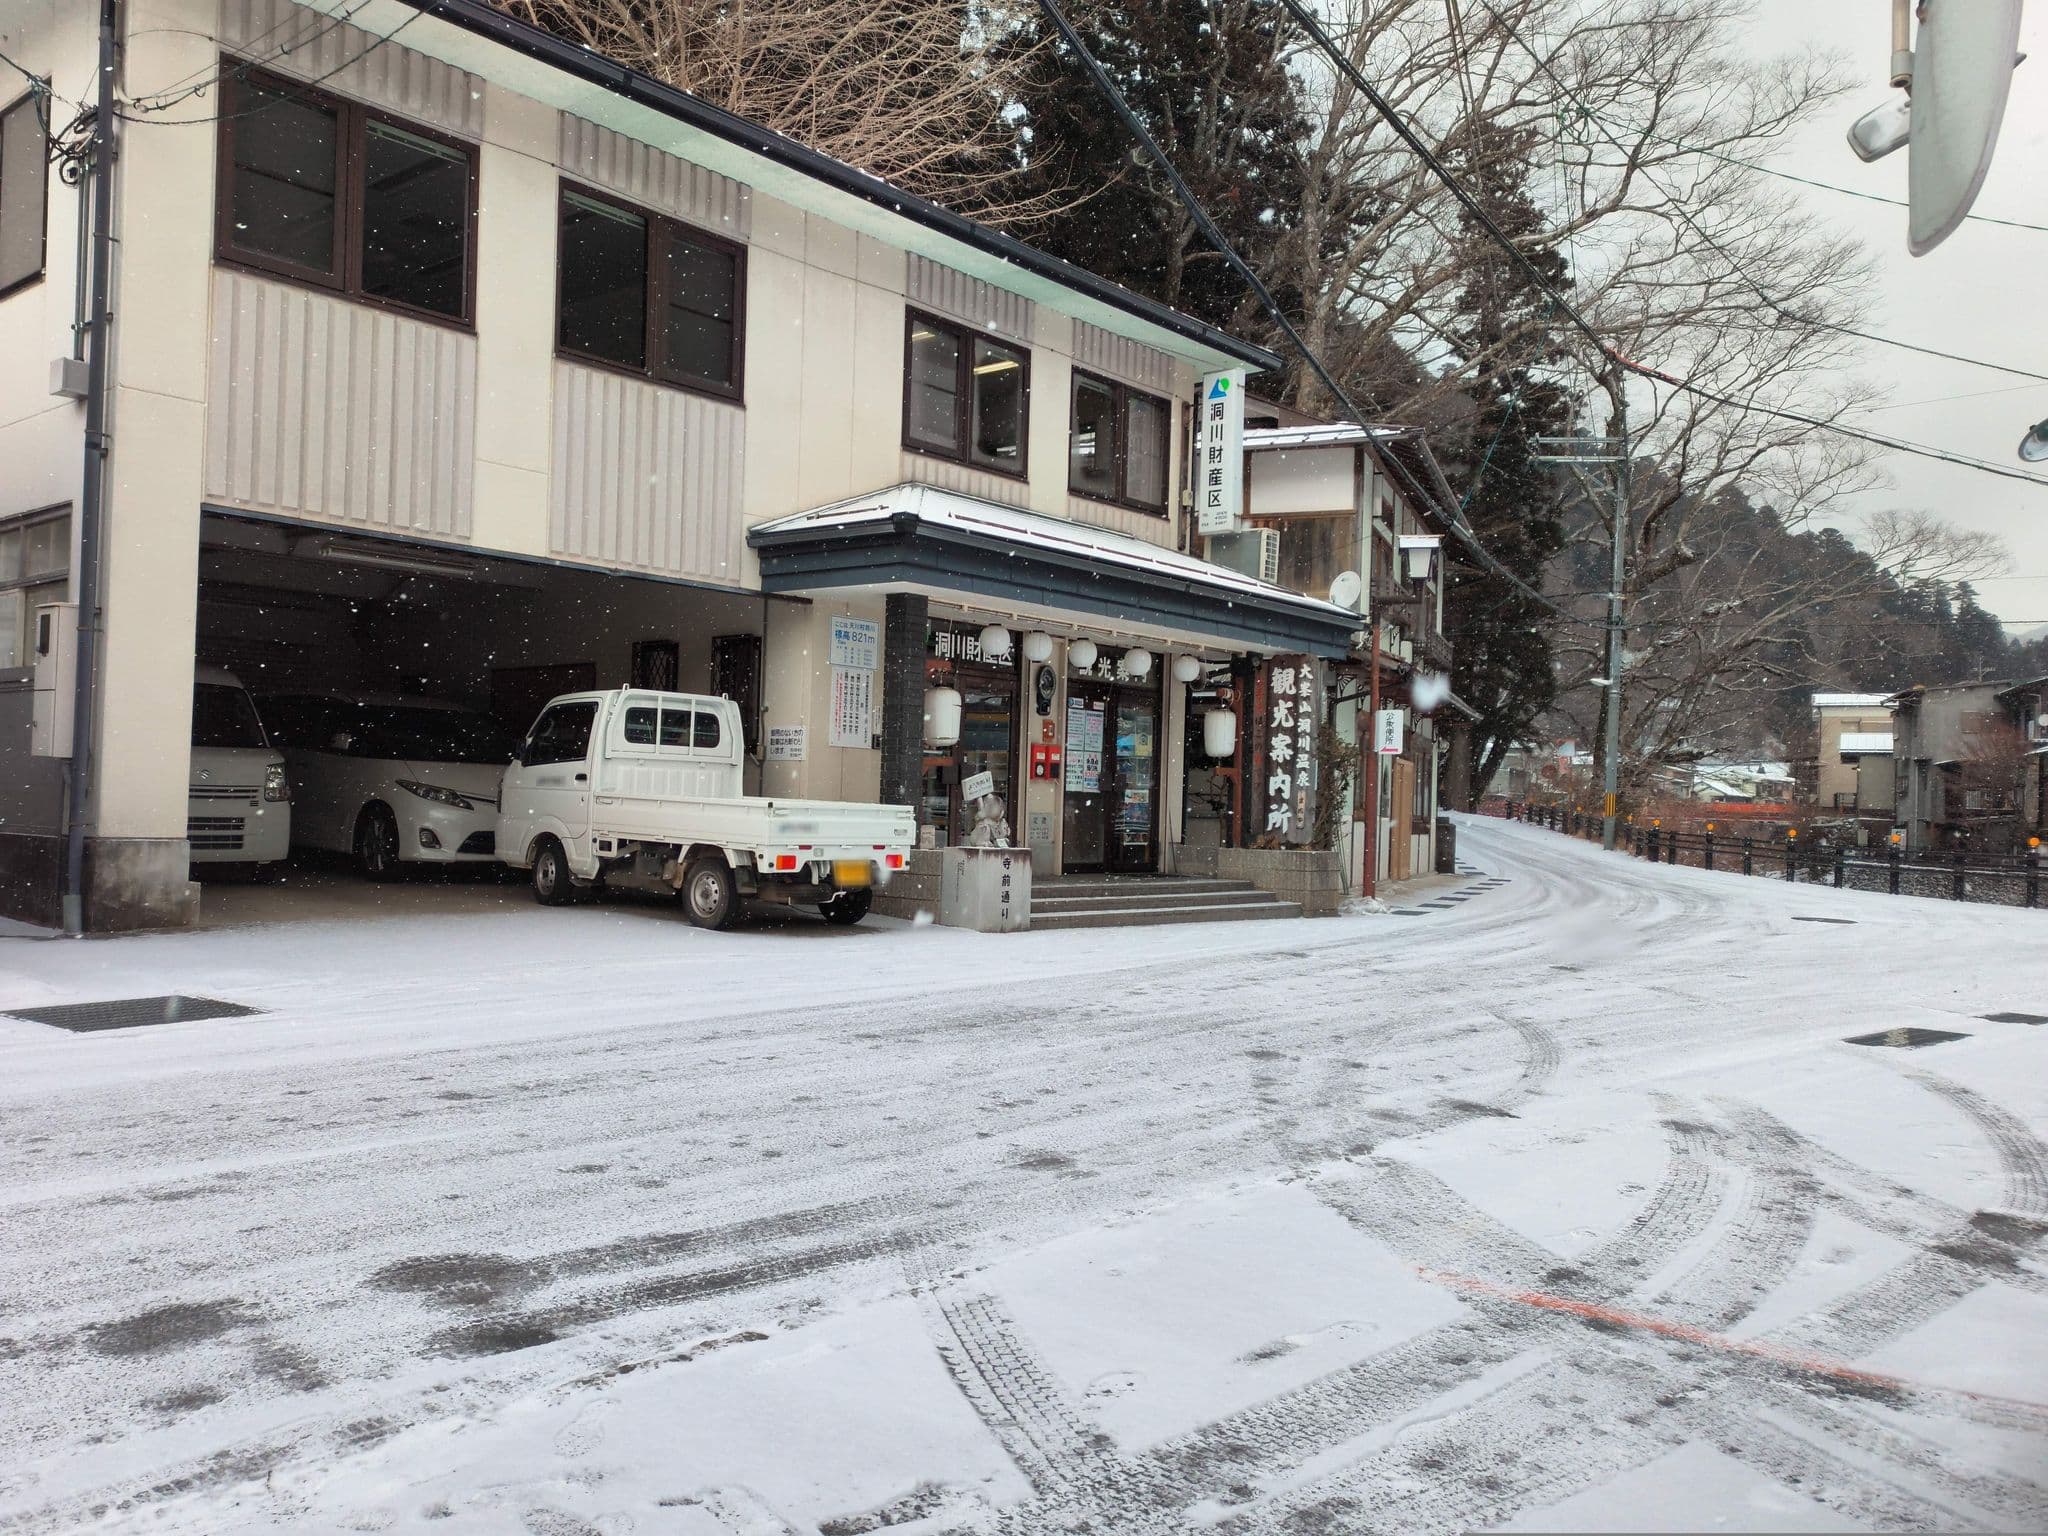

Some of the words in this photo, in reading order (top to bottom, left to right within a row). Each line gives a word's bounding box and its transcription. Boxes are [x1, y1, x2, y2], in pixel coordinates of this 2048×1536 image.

[1208, 402, 1225, 508] 洞川財産区
[1266, 667, 1298, 834] 観光案内所
[1001, 857, 1012, 920] 寺前通り
